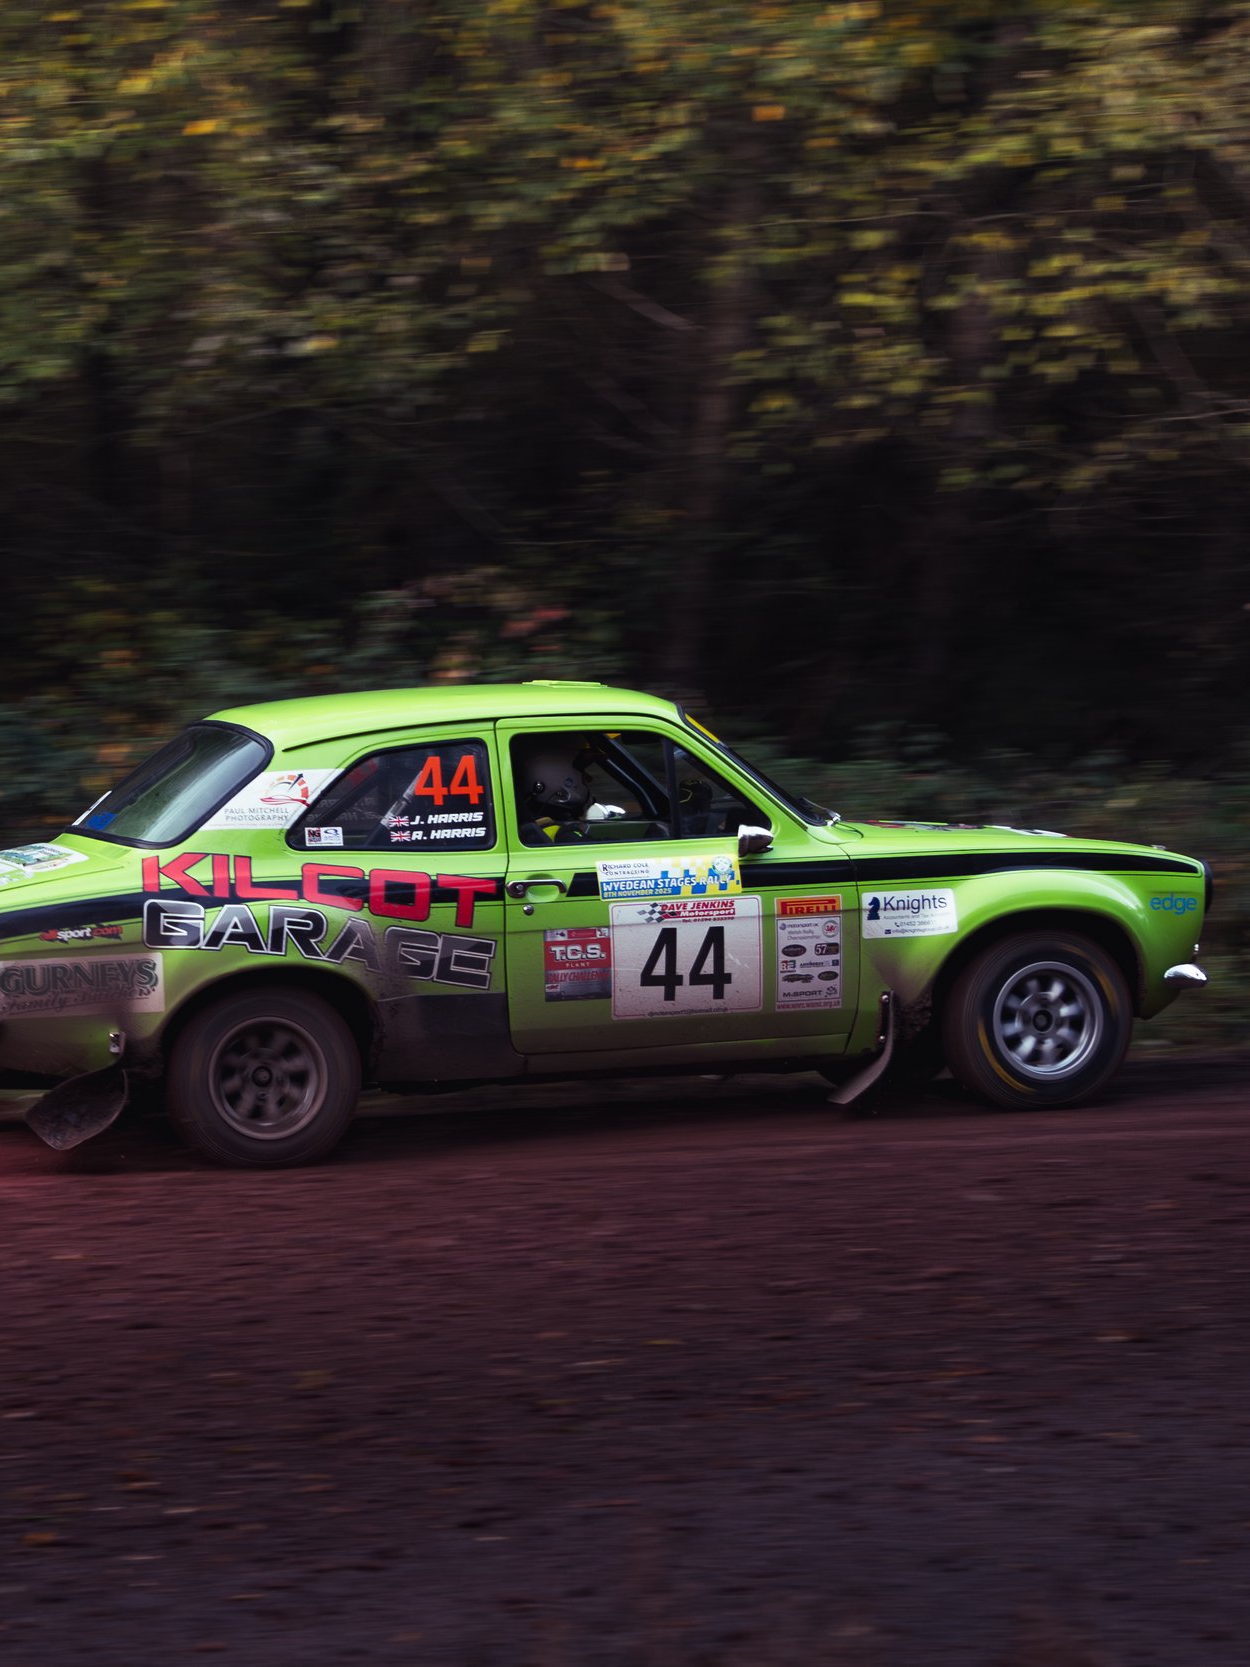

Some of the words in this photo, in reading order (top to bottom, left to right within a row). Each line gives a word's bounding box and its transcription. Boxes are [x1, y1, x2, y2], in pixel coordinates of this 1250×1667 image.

[414, 755, 484, 806] 44
[224, 808, 245, 816] PAUL
[248, 807, 290, 815] MITCHELL
[225, 814, 290, 822] PHOTOGRAPHY
[410, 815, 425, 825] J.
[427, 812, 484, 824] HARRIS
[411, 830, 427, 840] A.
[430, 827, 486, 840] HARRIS
[142, 852, 498, 928] KILCOT
[603, 879, 657, 892] WYEDEAN
[657, 876, 697, 888] STAGES
[699, 874, 732, 886] RALLY
[618, 889, 654, 897] NOVEMBER
[660, 902, 688, 912] DAVE
[690, 900, 735, 910] JENKINS
[781, 898, 837, 915] PIRELLI
[883, 895, 948, 914] Knights
[1150, 891, 1198, 916] edge
[679, 908, 735, 917] Motorsport
[143, 899, 498, 990] GARAGE
[549, 944, 607, 961] T.C.S.
[815, 944, 827, 955] 57
[640, 926, 732, 1001] 44
